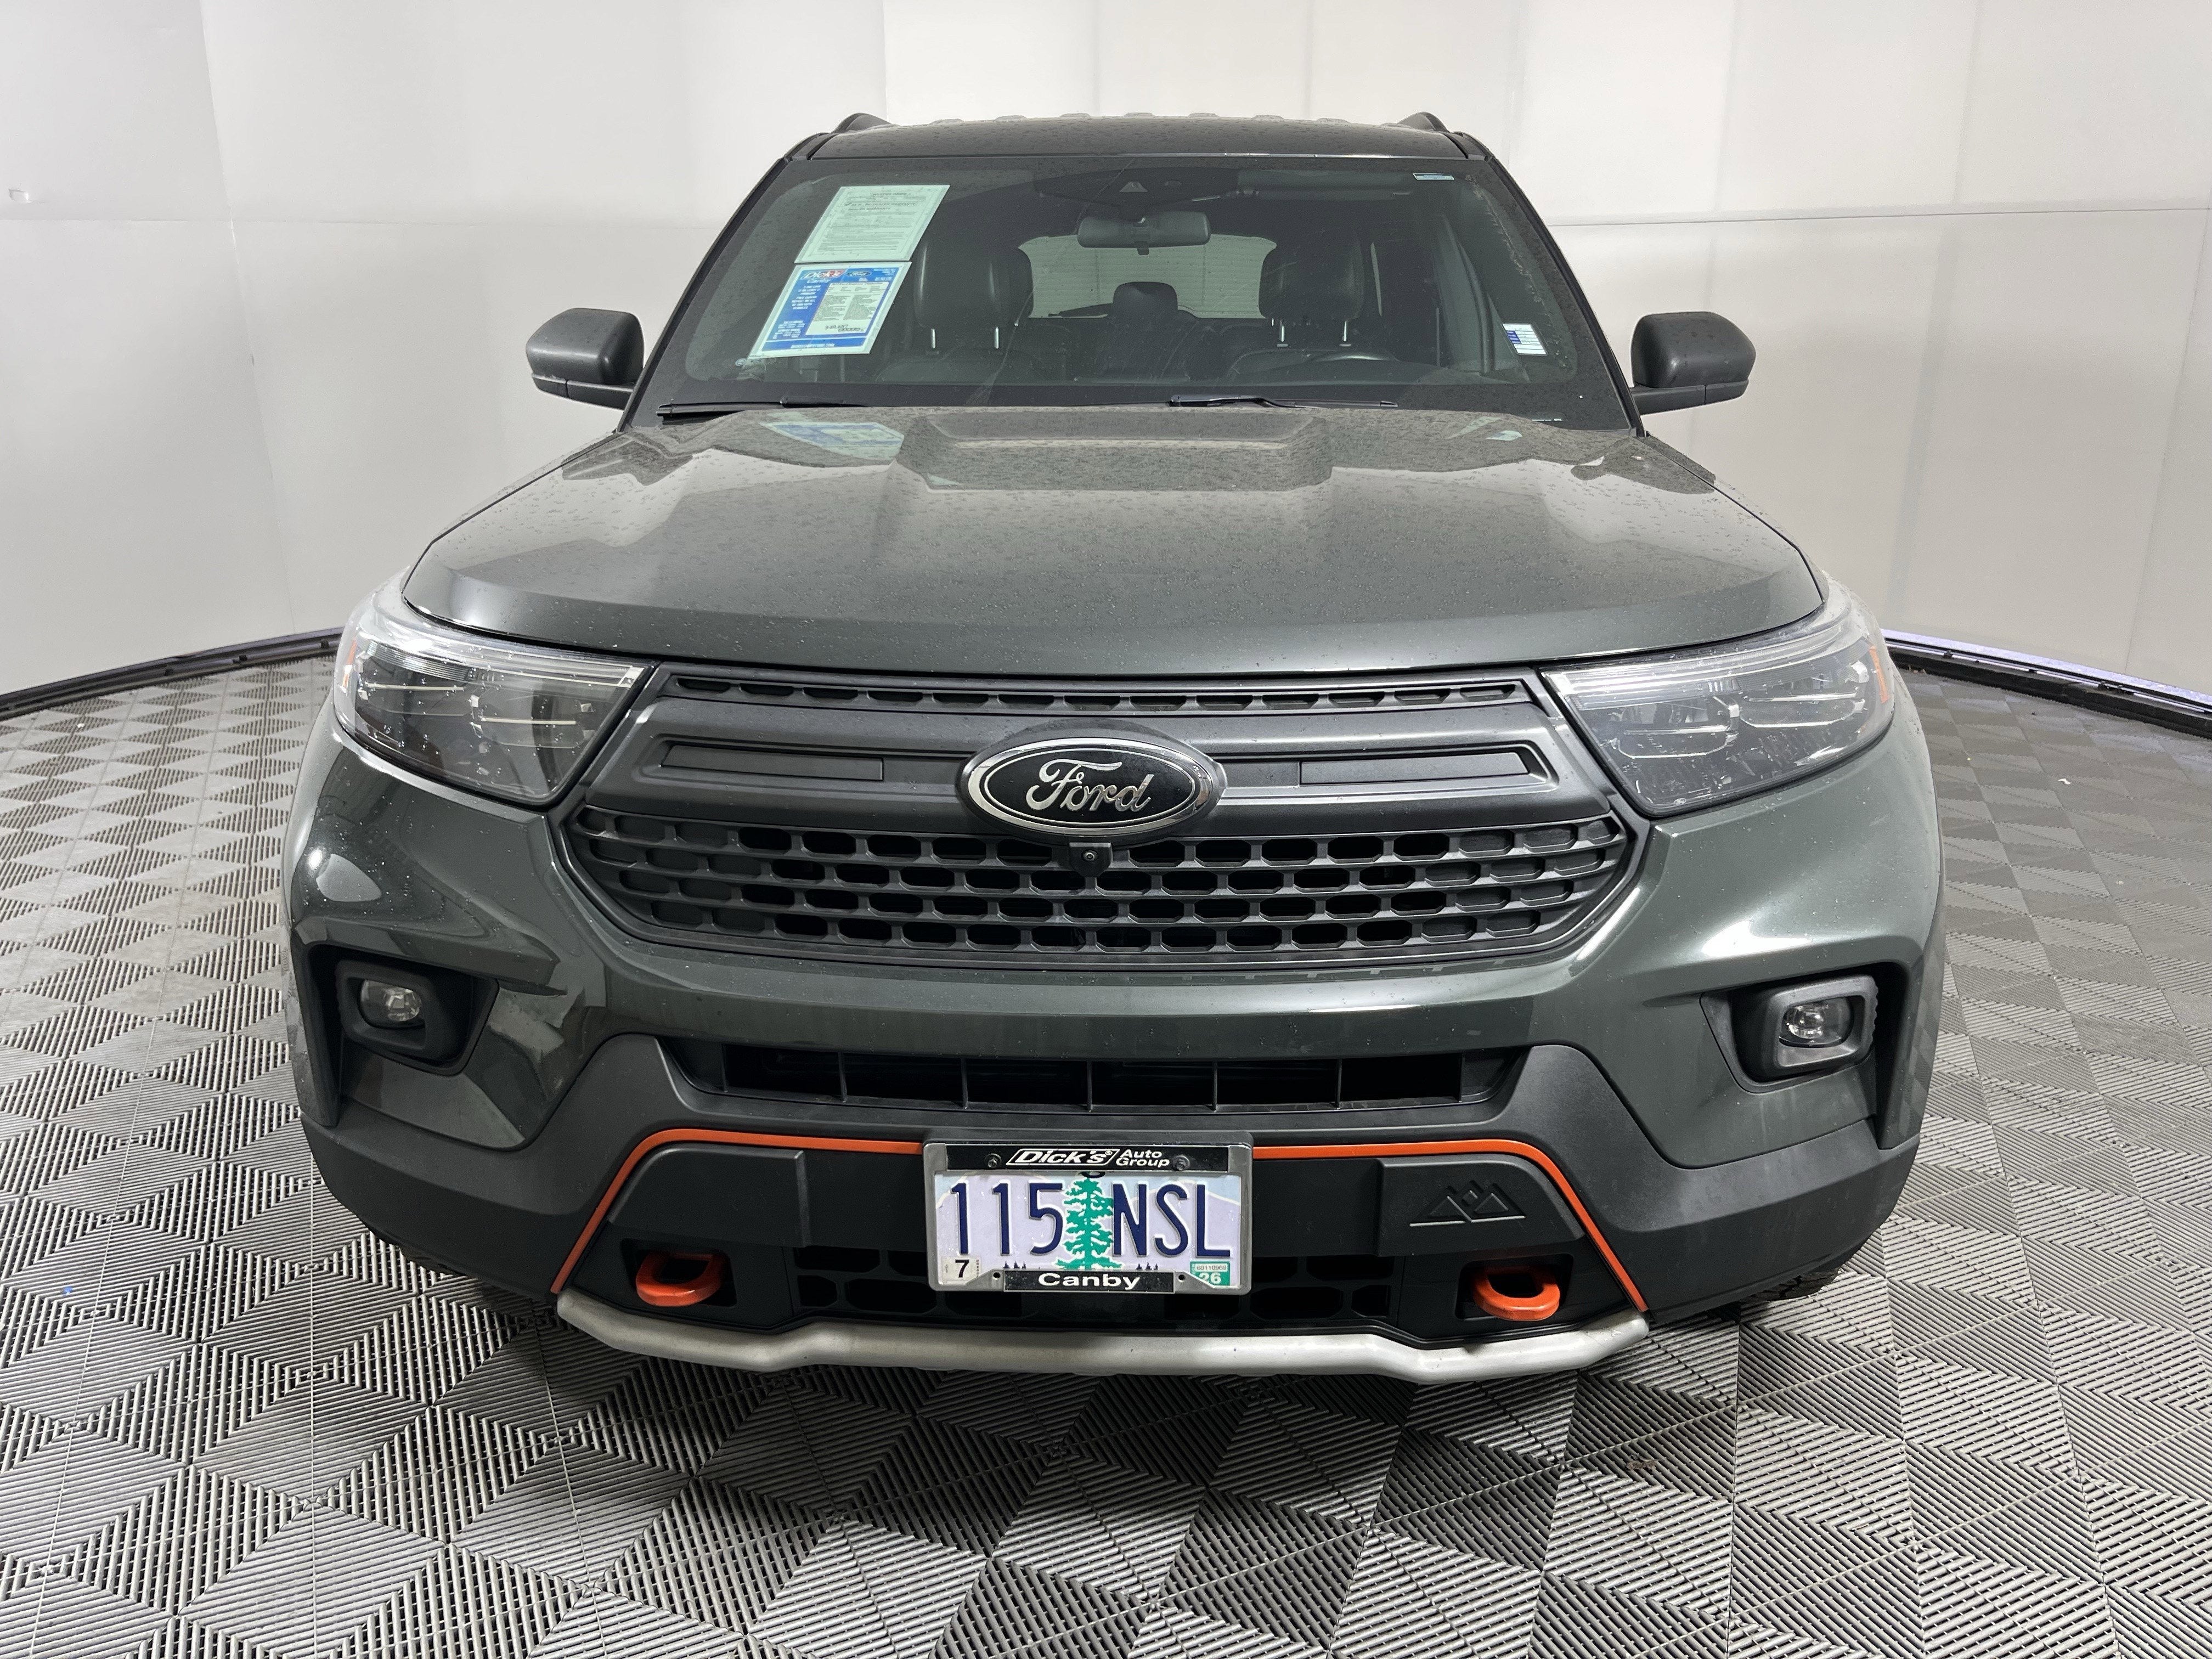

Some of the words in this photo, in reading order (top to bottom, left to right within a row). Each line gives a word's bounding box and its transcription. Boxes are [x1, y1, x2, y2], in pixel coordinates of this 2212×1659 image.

[1025, 759, 1154, 812] Ford
[1014, 1150, 1107, 1164] Dick's
[1121, 1149, 1163, 1159] Auto
[1115, 1157, 1170, 1167] Group
[950, 1182, 1064, 1256] 115
[1112, 1183, 1232, 1258] NSL
[955, 1259, 969, 1278] 7
[1038, 1273, 1140, 1290] Canby
[1199, 1272, 1222, 1284] 26
